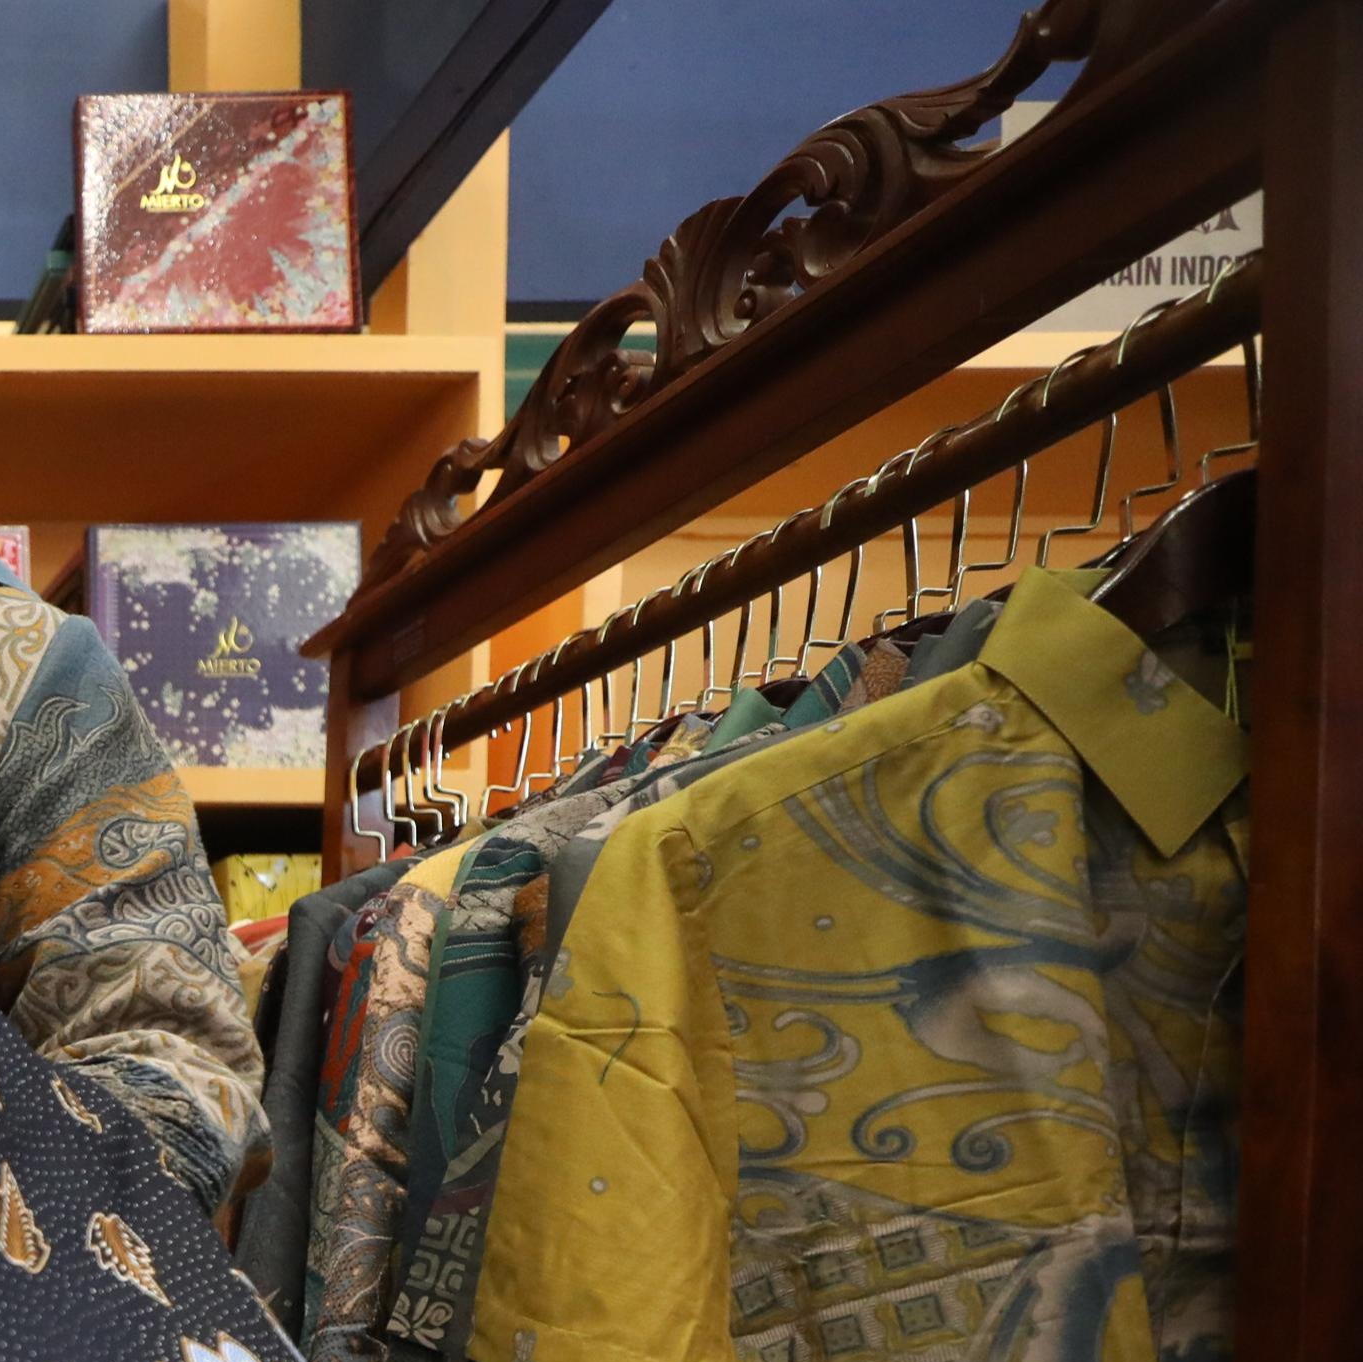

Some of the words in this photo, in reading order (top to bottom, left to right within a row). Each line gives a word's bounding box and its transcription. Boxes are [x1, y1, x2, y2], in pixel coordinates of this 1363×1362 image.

[139, 193, 205, 210] MIERTO
[1101, 255, 1163, 286] AIN
[1171, 254, 1254, 286] IND
[197, 656, 262, 675] MIERTO
